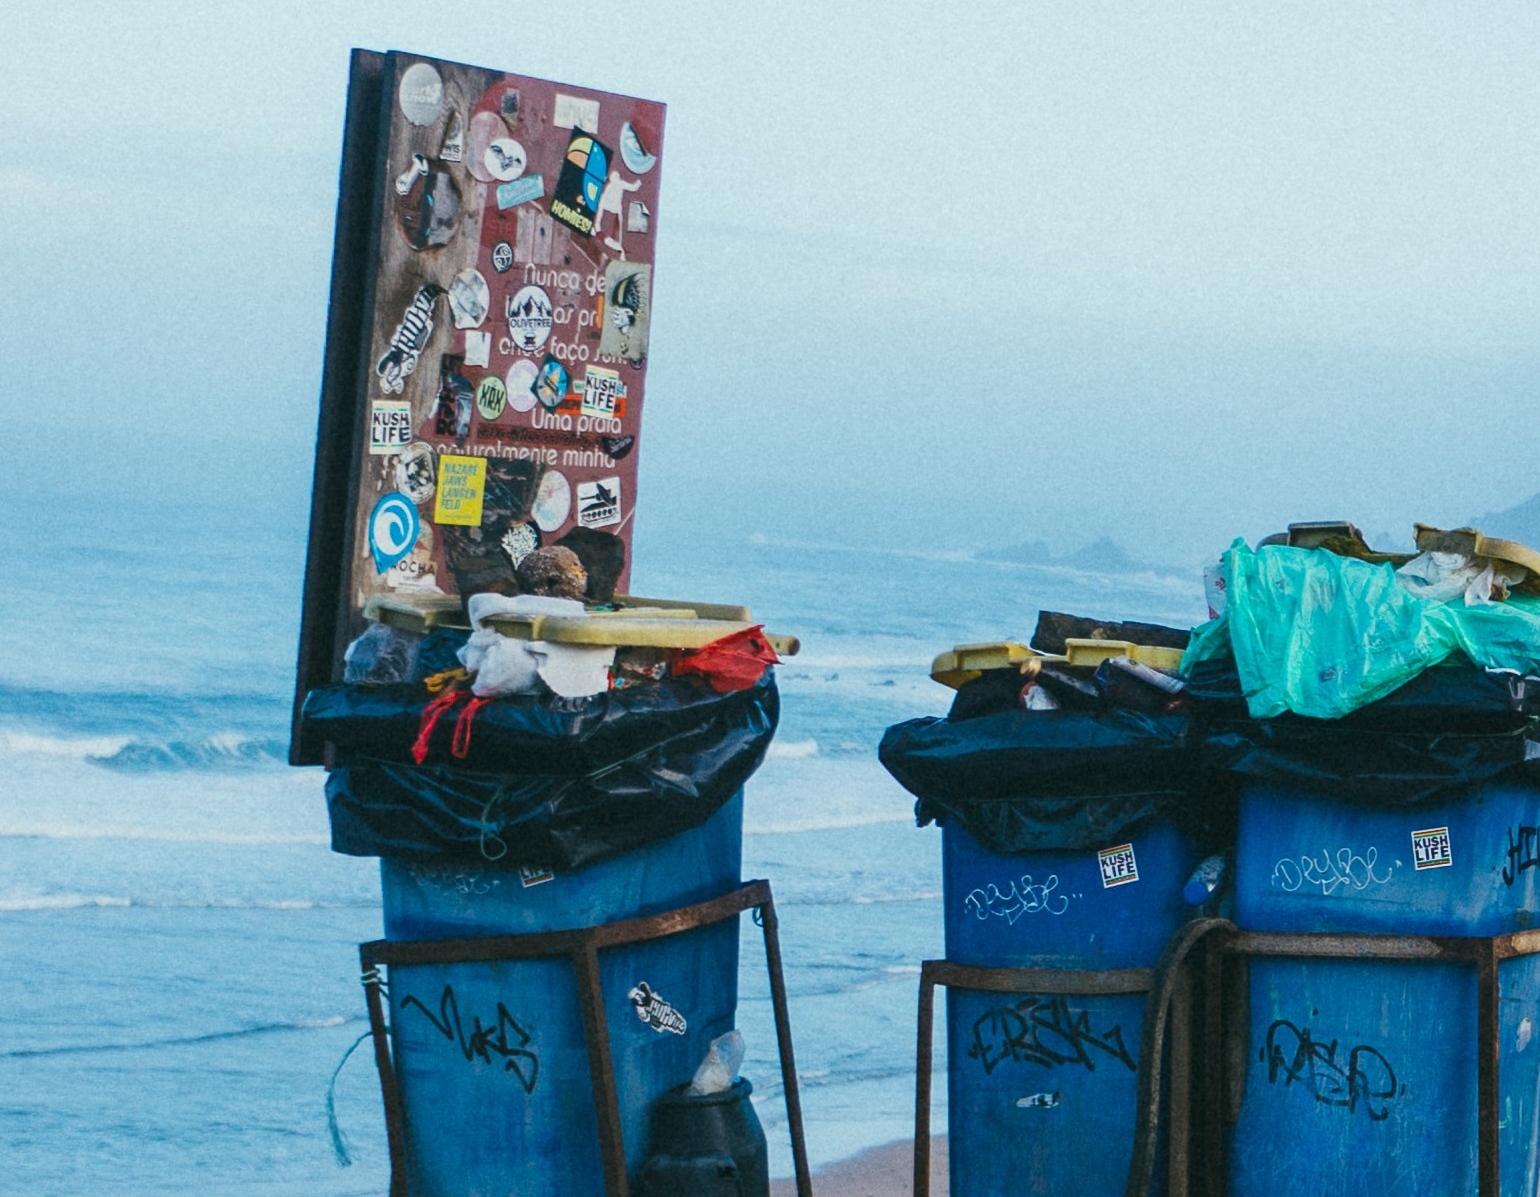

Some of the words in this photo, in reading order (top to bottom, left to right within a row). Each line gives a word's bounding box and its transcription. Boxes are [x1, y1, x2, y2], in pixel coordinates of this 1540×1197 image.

[510, 316, 552, 329] OLIVETREE
[550, 336, 589, 366] faço
[585, 375, 616, 394] KUSH
[583, 390, 615, 410] LIFE
[372, 411, 409, 426] KUSH
[531, 407, 572, 431] Uma
[372, 425, 411, 444] LIFE
[1414, 835, 1448, 850] KUSH
[1101, 850, 1133, 868] KUSH
[1415, 845, 1450, 862] LIFE
[1103, 862, 1136, 880] LIFE
